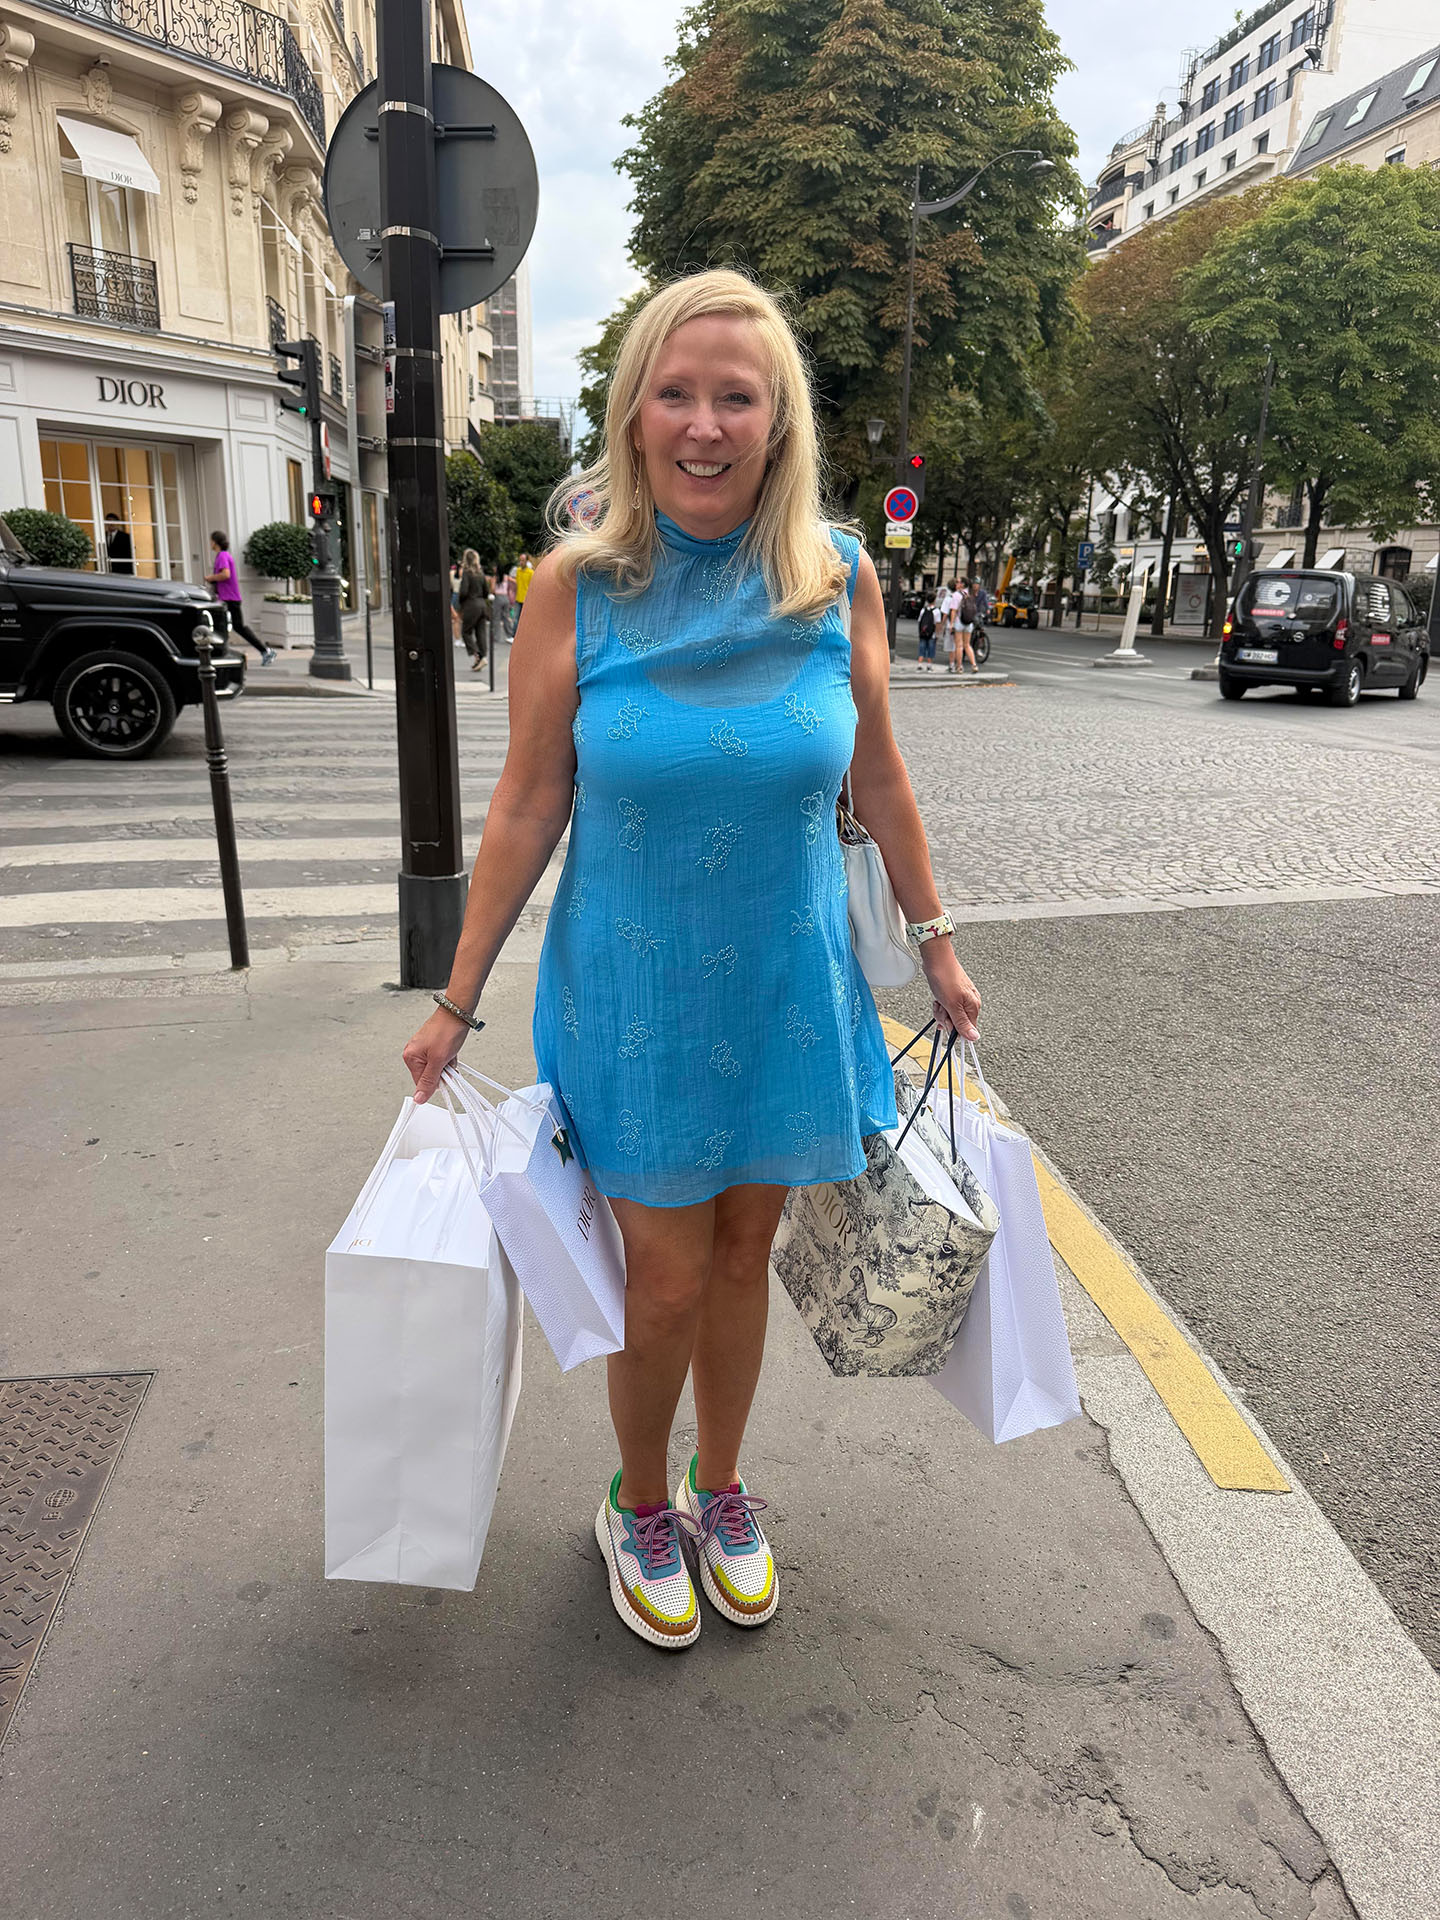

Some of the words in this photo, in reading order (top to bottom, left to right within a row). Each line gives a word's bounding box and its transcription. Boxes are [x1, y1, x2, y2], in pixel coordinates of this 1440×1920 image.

[110, 171, 133, 184] DIOR
[95, 376, 168, 410] DIOR
[577, 1186, 597, 1241] DIOR
[814, 1184, 853, 1247] DIOR
